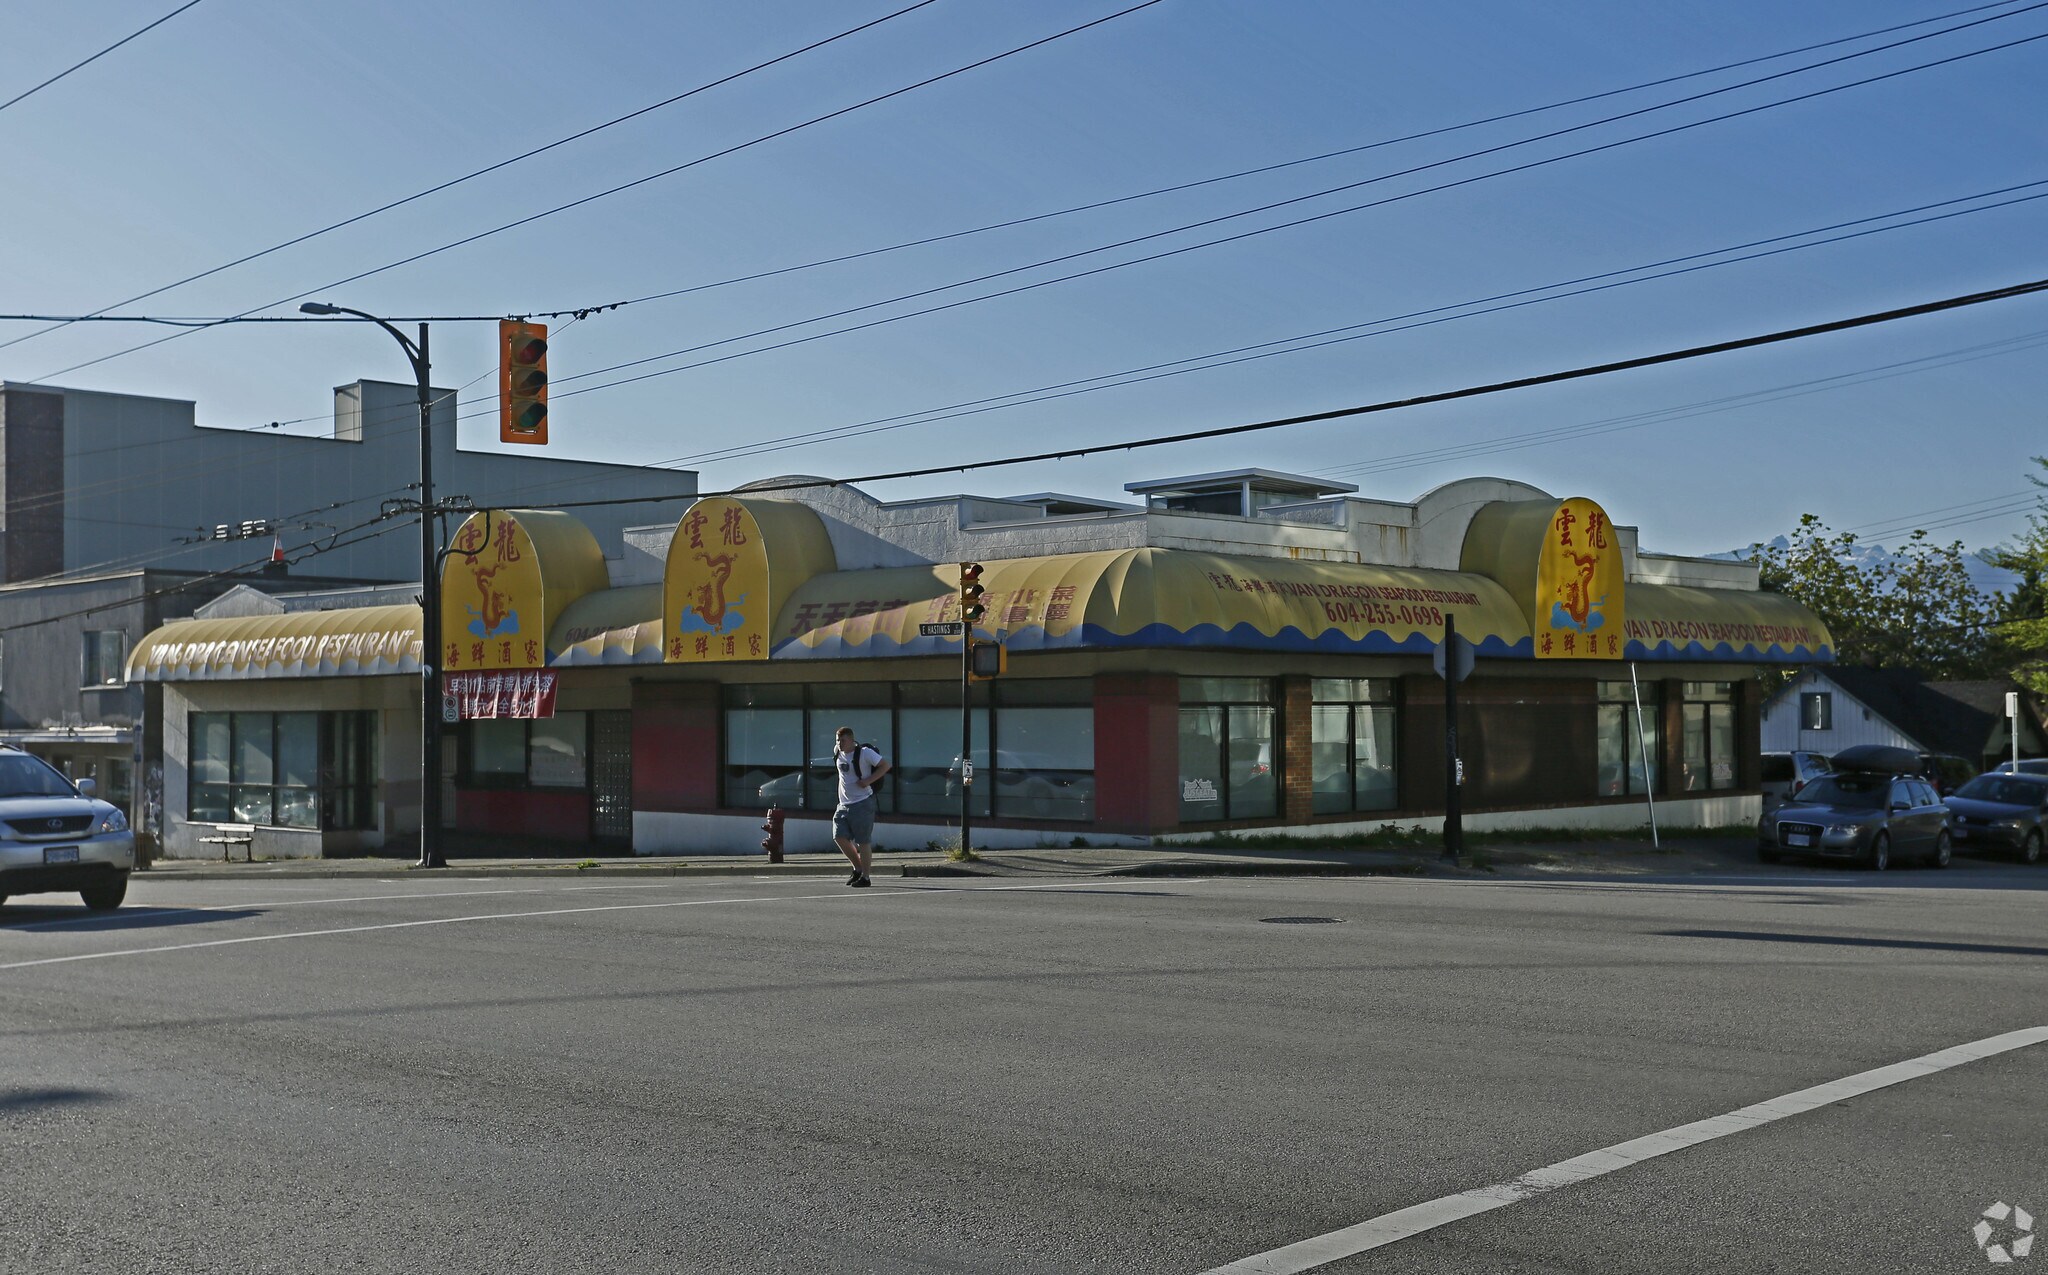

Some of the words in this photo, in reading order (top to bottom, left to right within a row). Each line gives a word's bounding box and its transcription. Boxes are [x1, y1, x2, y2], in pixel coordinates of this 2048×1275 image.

[684, 507, 746, 549] 雲龍
[1555, 508, 1606, 549] 雲龍
[459, 521, 519, 565] 雲龍
[1284, 582, 1319, 598] VAN
[1317, 585, 1381, 599] DRAGON
[1378, 586, 1424, 602] SEAFOOD
[1423, 589, 1481, 606] RESTAURANT
[1325, 602, 1443, 626] 604-255-0698
[928, 624, 951, 635] HASTINGS
[1624, 619, 1652, 639] VAN
[1653, 619, 1709, 640] DRAGON
[1708, 622, 1756, 642] SEAFOOD
[1754, 624, 1811, 644] RESTAURANT
[251, 634, 317, 662] SEAFOOD
[316, 629, 415, 658] RESTAURANT
[447, 640, 537, 667] 海鮮酒家
[671, 633, 761, 659] 海鮮酒家
[1541, 633, 1616, 656] 海鮮酒家
